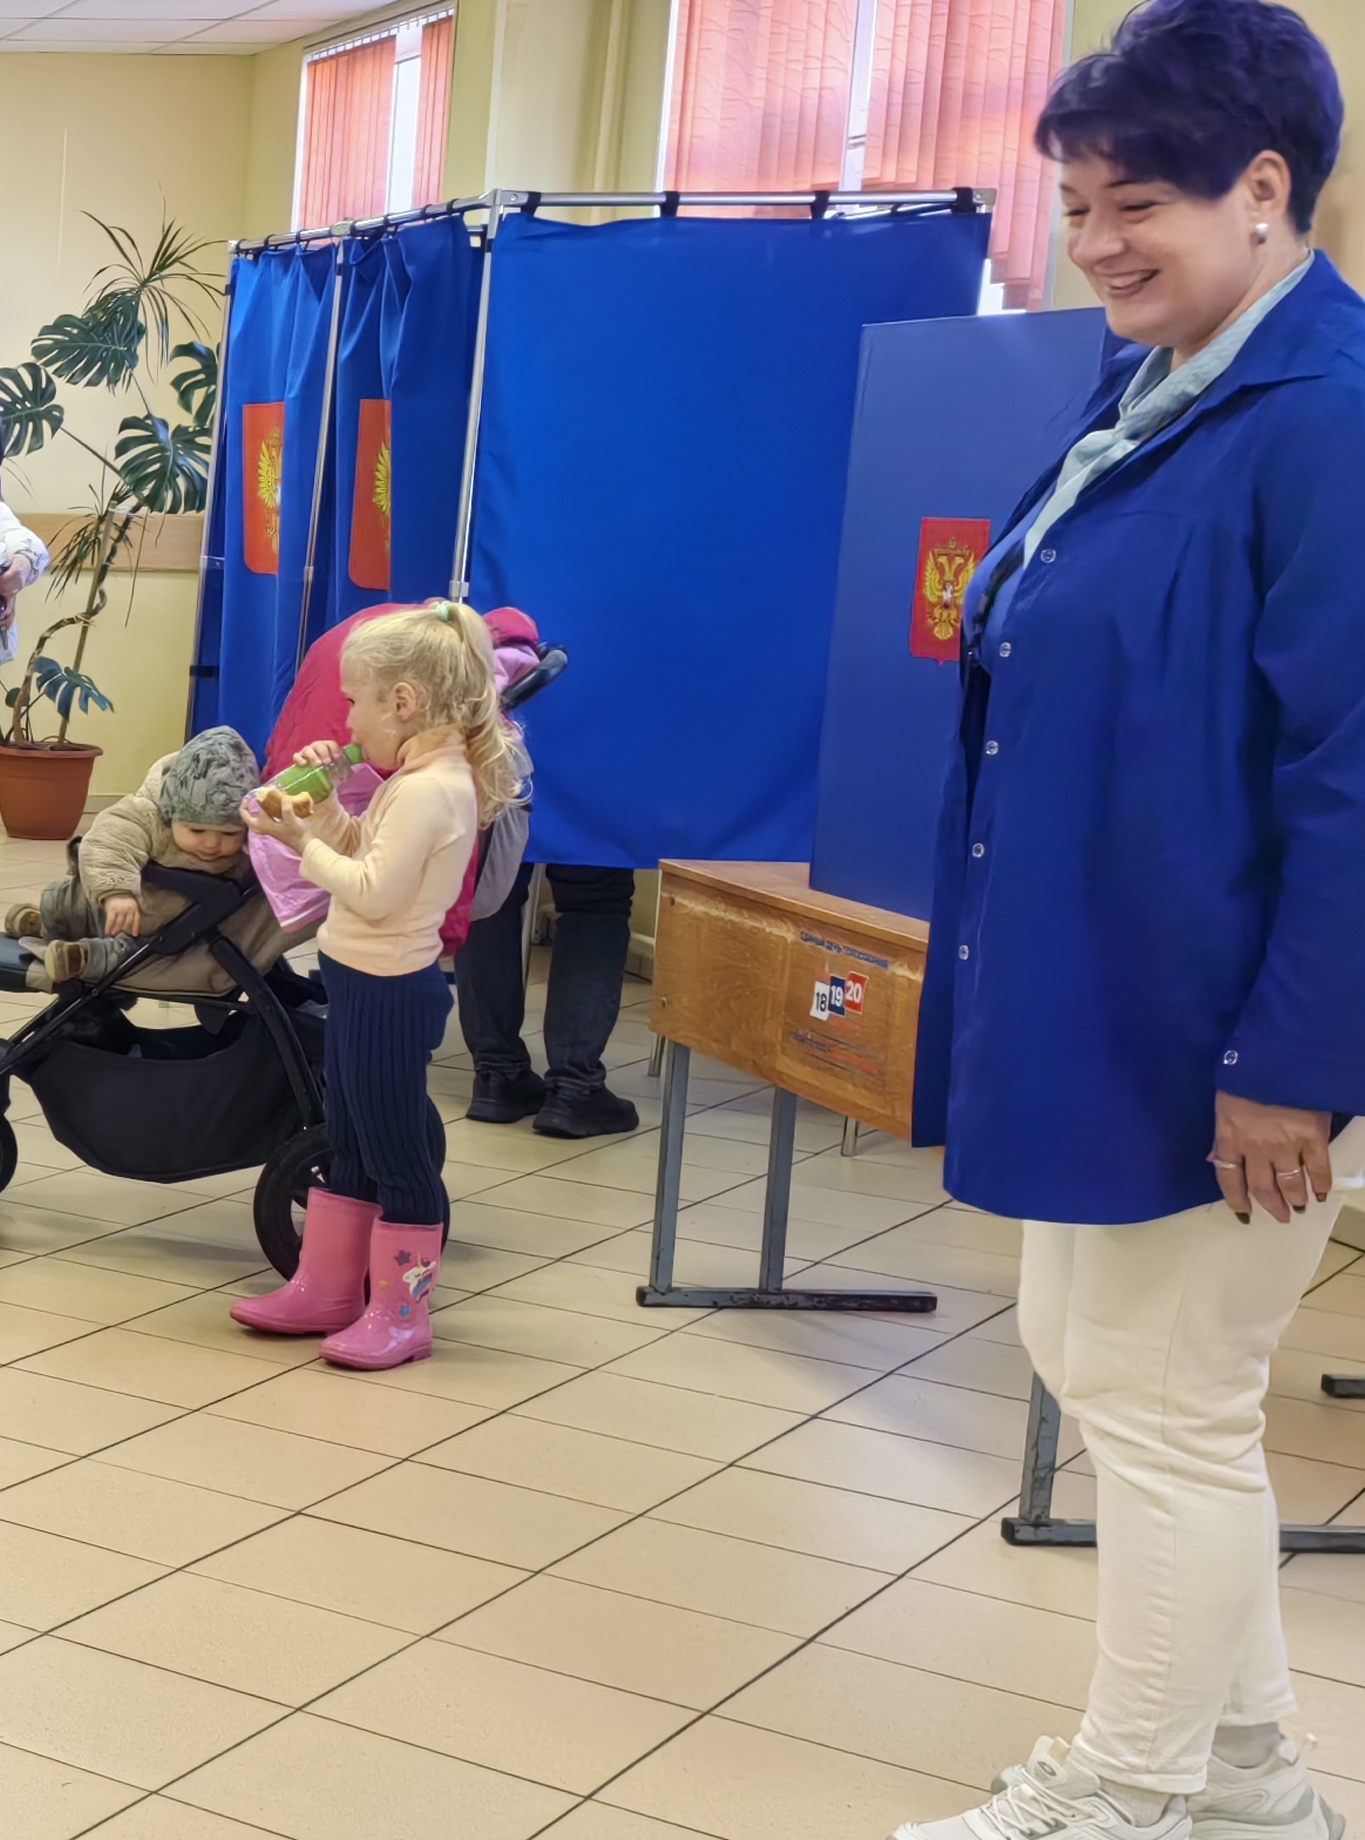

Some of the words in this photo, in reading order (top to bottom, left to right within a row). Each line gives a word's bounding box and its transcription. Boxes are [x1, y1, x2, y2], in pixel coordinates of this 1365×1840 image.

[815, 992, 828, 1012] 18
[830, 985, 844, 1007] 19
[845, 980, 863, 1004] 20
